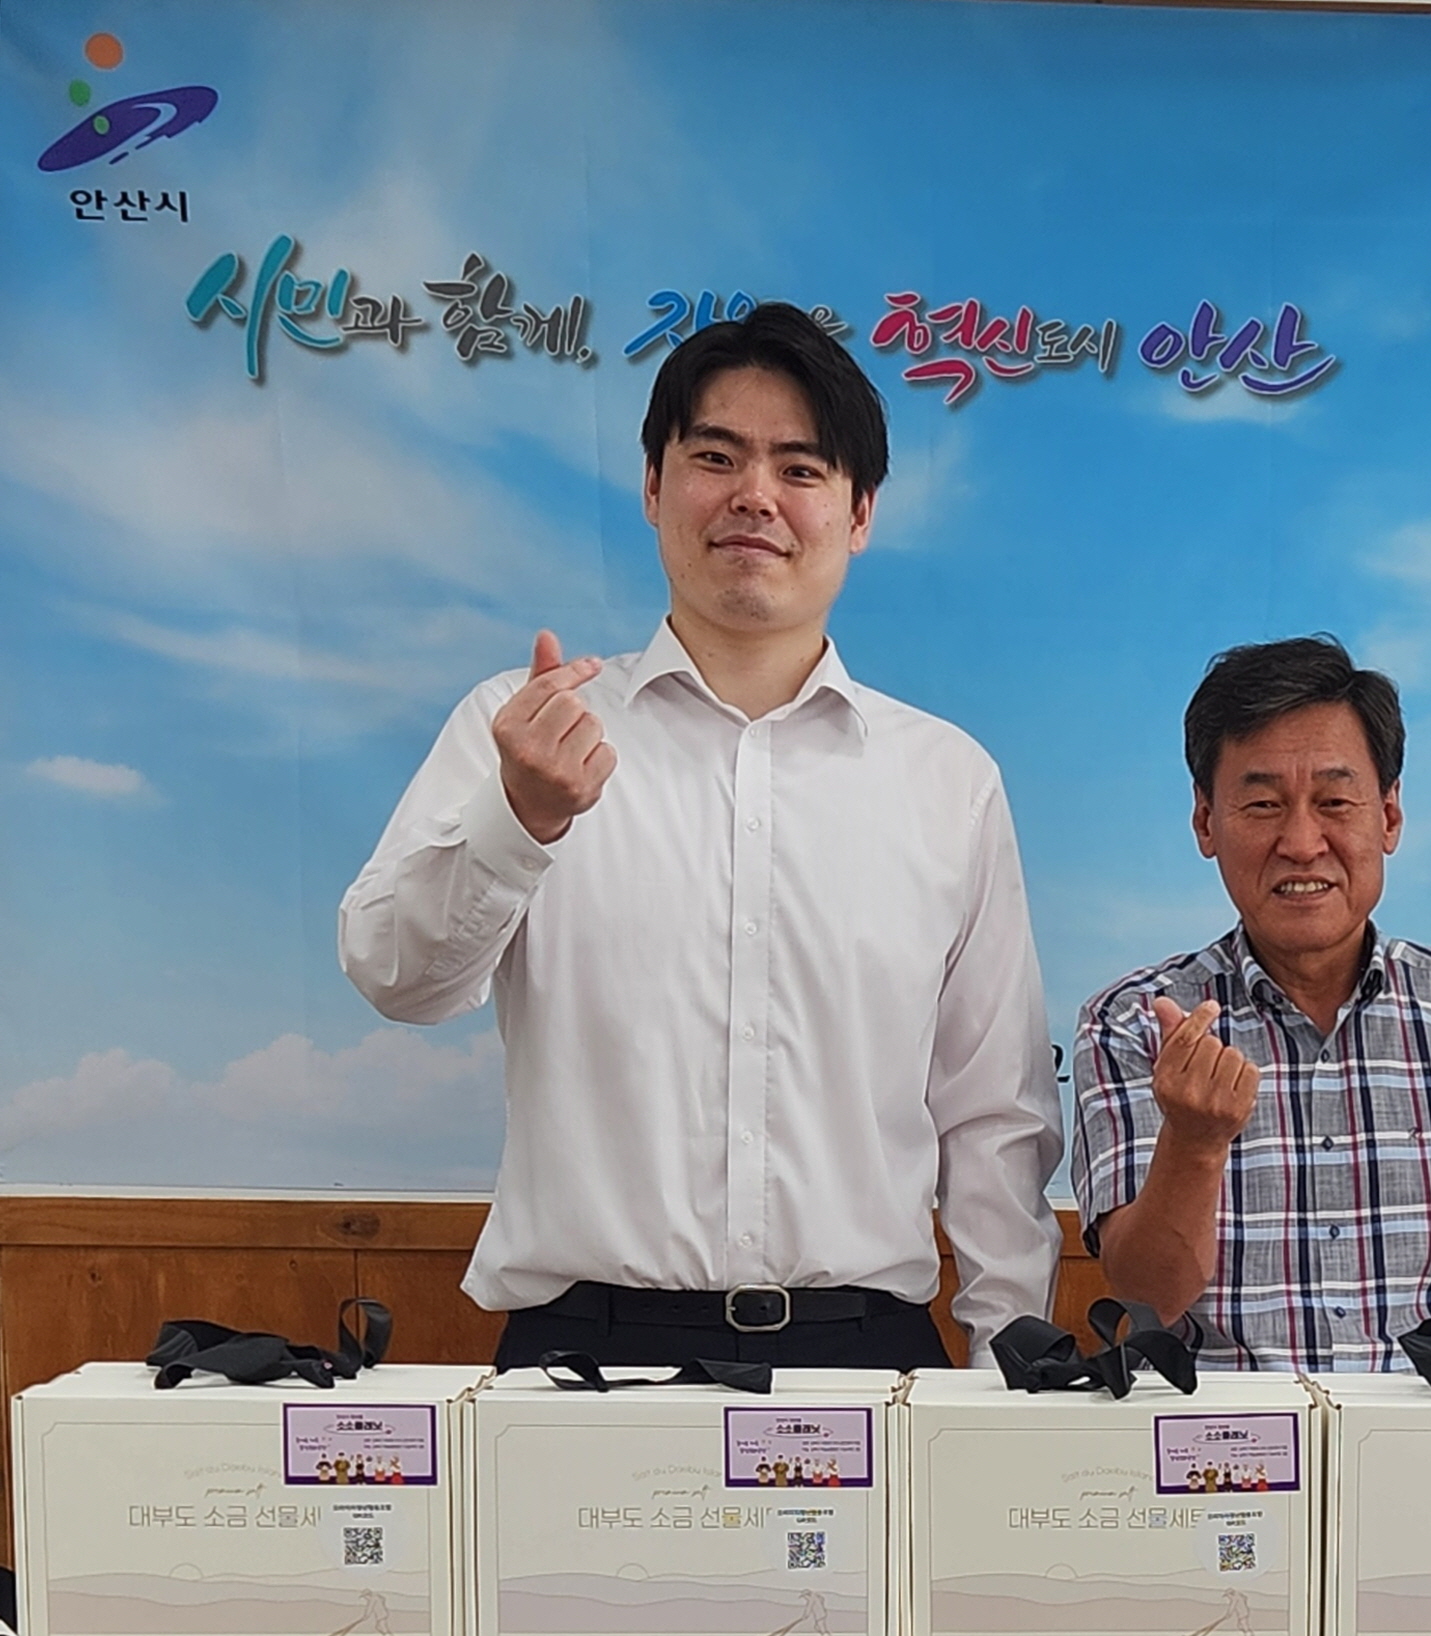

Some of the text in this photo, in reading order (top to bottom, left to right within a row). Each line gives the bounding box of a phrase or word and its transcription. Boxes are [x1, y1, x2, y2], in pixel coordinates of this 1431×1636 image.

[69, 189, 188, 222] 안산시
[186, 234, 423, 379] 시민과
[422, 251, 590, 362] 함께,
[870, 290, 1117, 404] 혁신도시
[1138, 299, 1337, 395] 안산
[129, 1505, 196, 1528] 대부도
[203, 1506, 248, 1528] 소금
[255, 1505, 321, 1529] 선물세
[578, 1507, 643, 1529] 대부도
[650, 1507, 693, 1529] 소금
[699, 1506, 773, 1529] 선물세
[1009, 1507, 1072, 1529] 대부도
[1078, 1507, 1121, 1529] 소금
